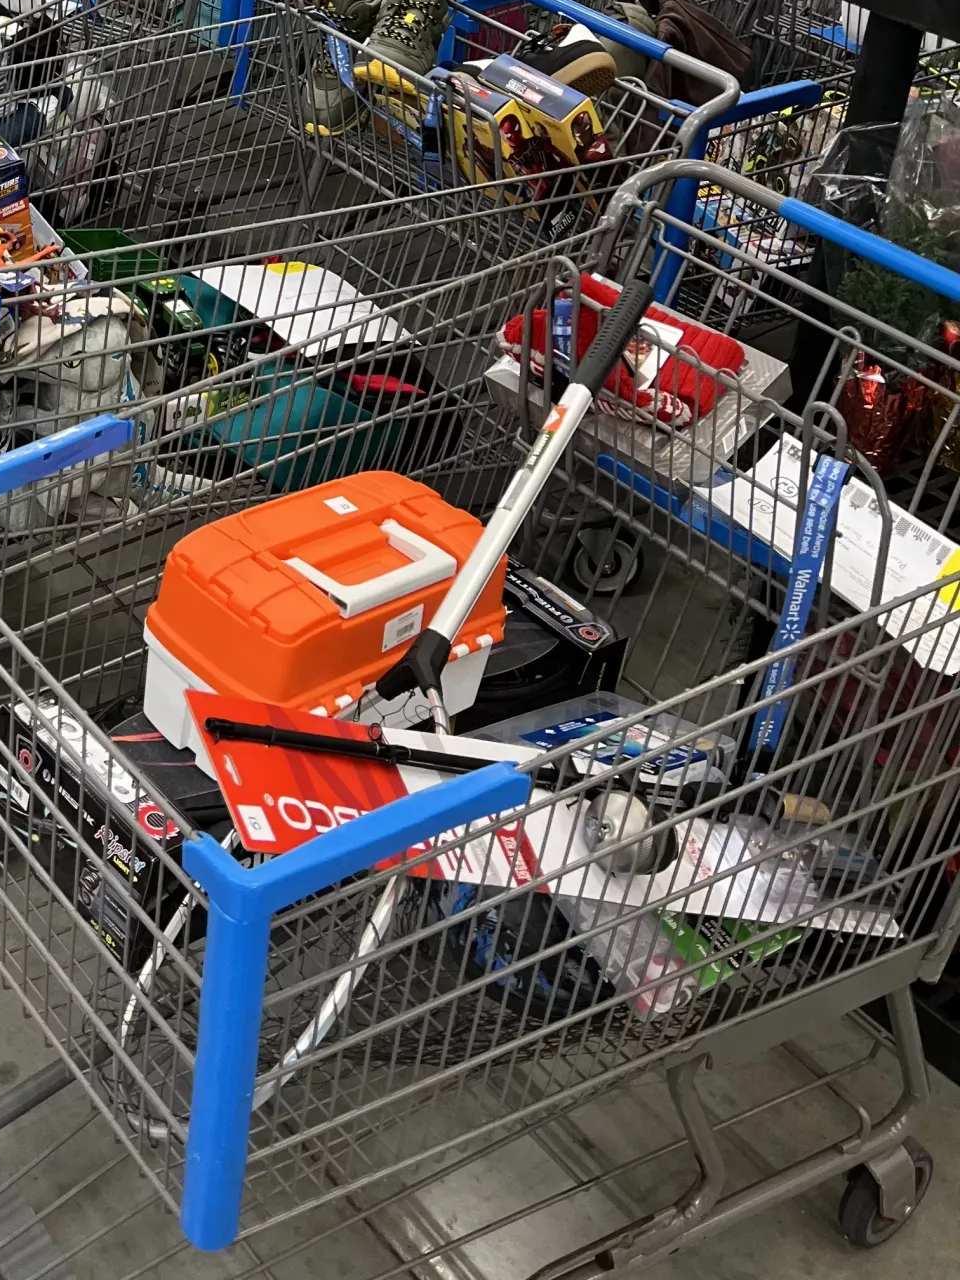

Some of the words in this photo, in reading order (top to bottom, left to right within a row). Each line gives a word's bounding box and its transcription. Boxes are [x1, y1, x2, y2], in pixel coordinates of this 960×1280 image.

[548, 210, 576, 238] LEGENDS
[807, 504, 816, 517] use
[805, 518, 815, 536] seat
[811, 533, 826, 558] Always
[788, 569, 812, 621] Walmart
[94, 825, 146, 873] Ripster
[112, 855, 131, 875] LIGHT
